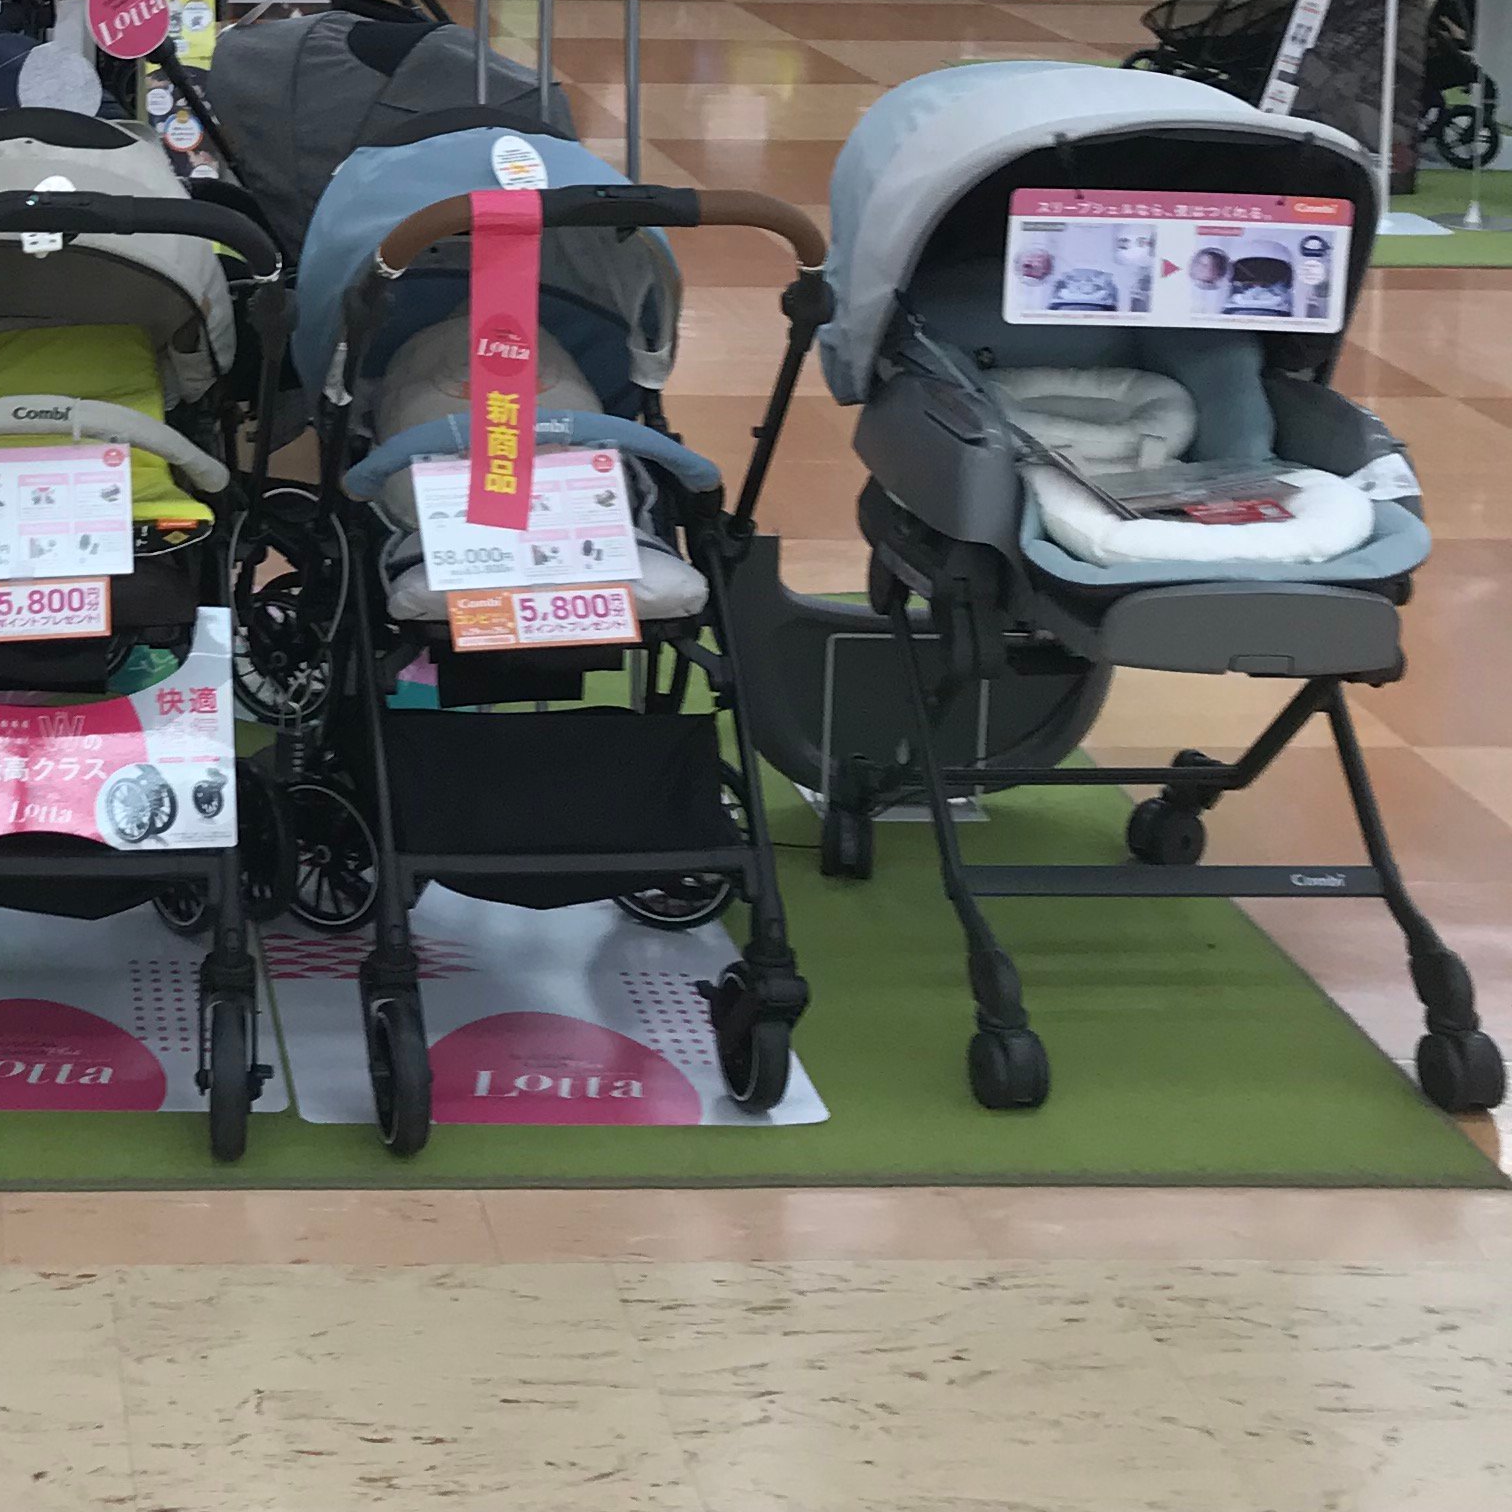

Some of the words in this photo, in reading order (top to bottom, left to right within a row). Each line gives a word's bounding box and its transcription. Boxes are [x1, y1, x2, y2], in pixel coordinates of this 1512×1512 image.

[11, 405, 73, 422] Combi
[535, 417, 572, 433] mbi
[484, 390, 520, 495] 新商品
[432, 547, 514, 566] 58,000円
[519, 593, 609, 622] 5,800
[155, 686, 219, 715] 快適
[468, 1070, 644, 1099] Lotta
